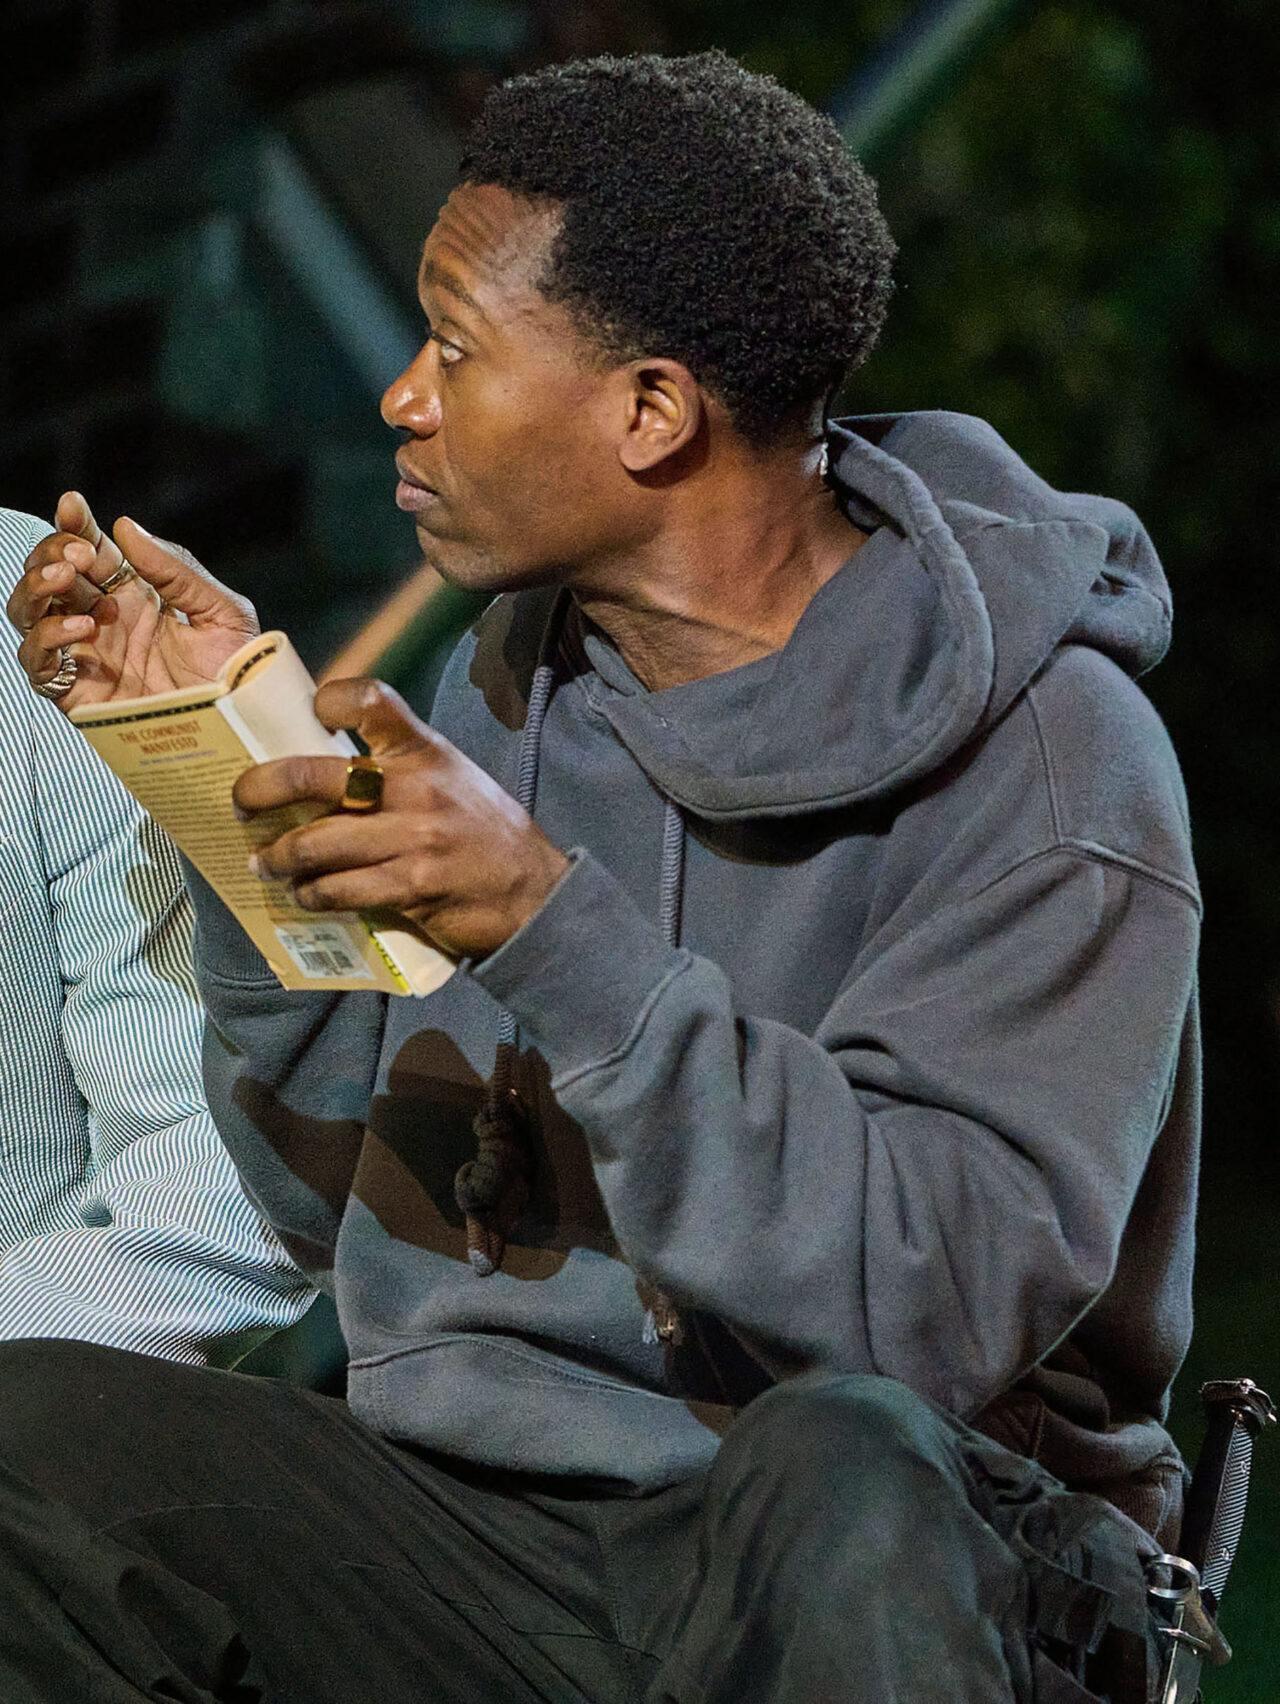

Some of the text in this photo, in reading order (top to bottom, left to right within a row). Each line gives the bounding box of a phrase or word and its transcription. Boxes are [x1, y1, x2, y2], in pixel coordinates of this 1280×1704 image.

[117, 720, 201, 743] THE COMMUNIST
[140, 736, 199, 754] MANIFESTO
